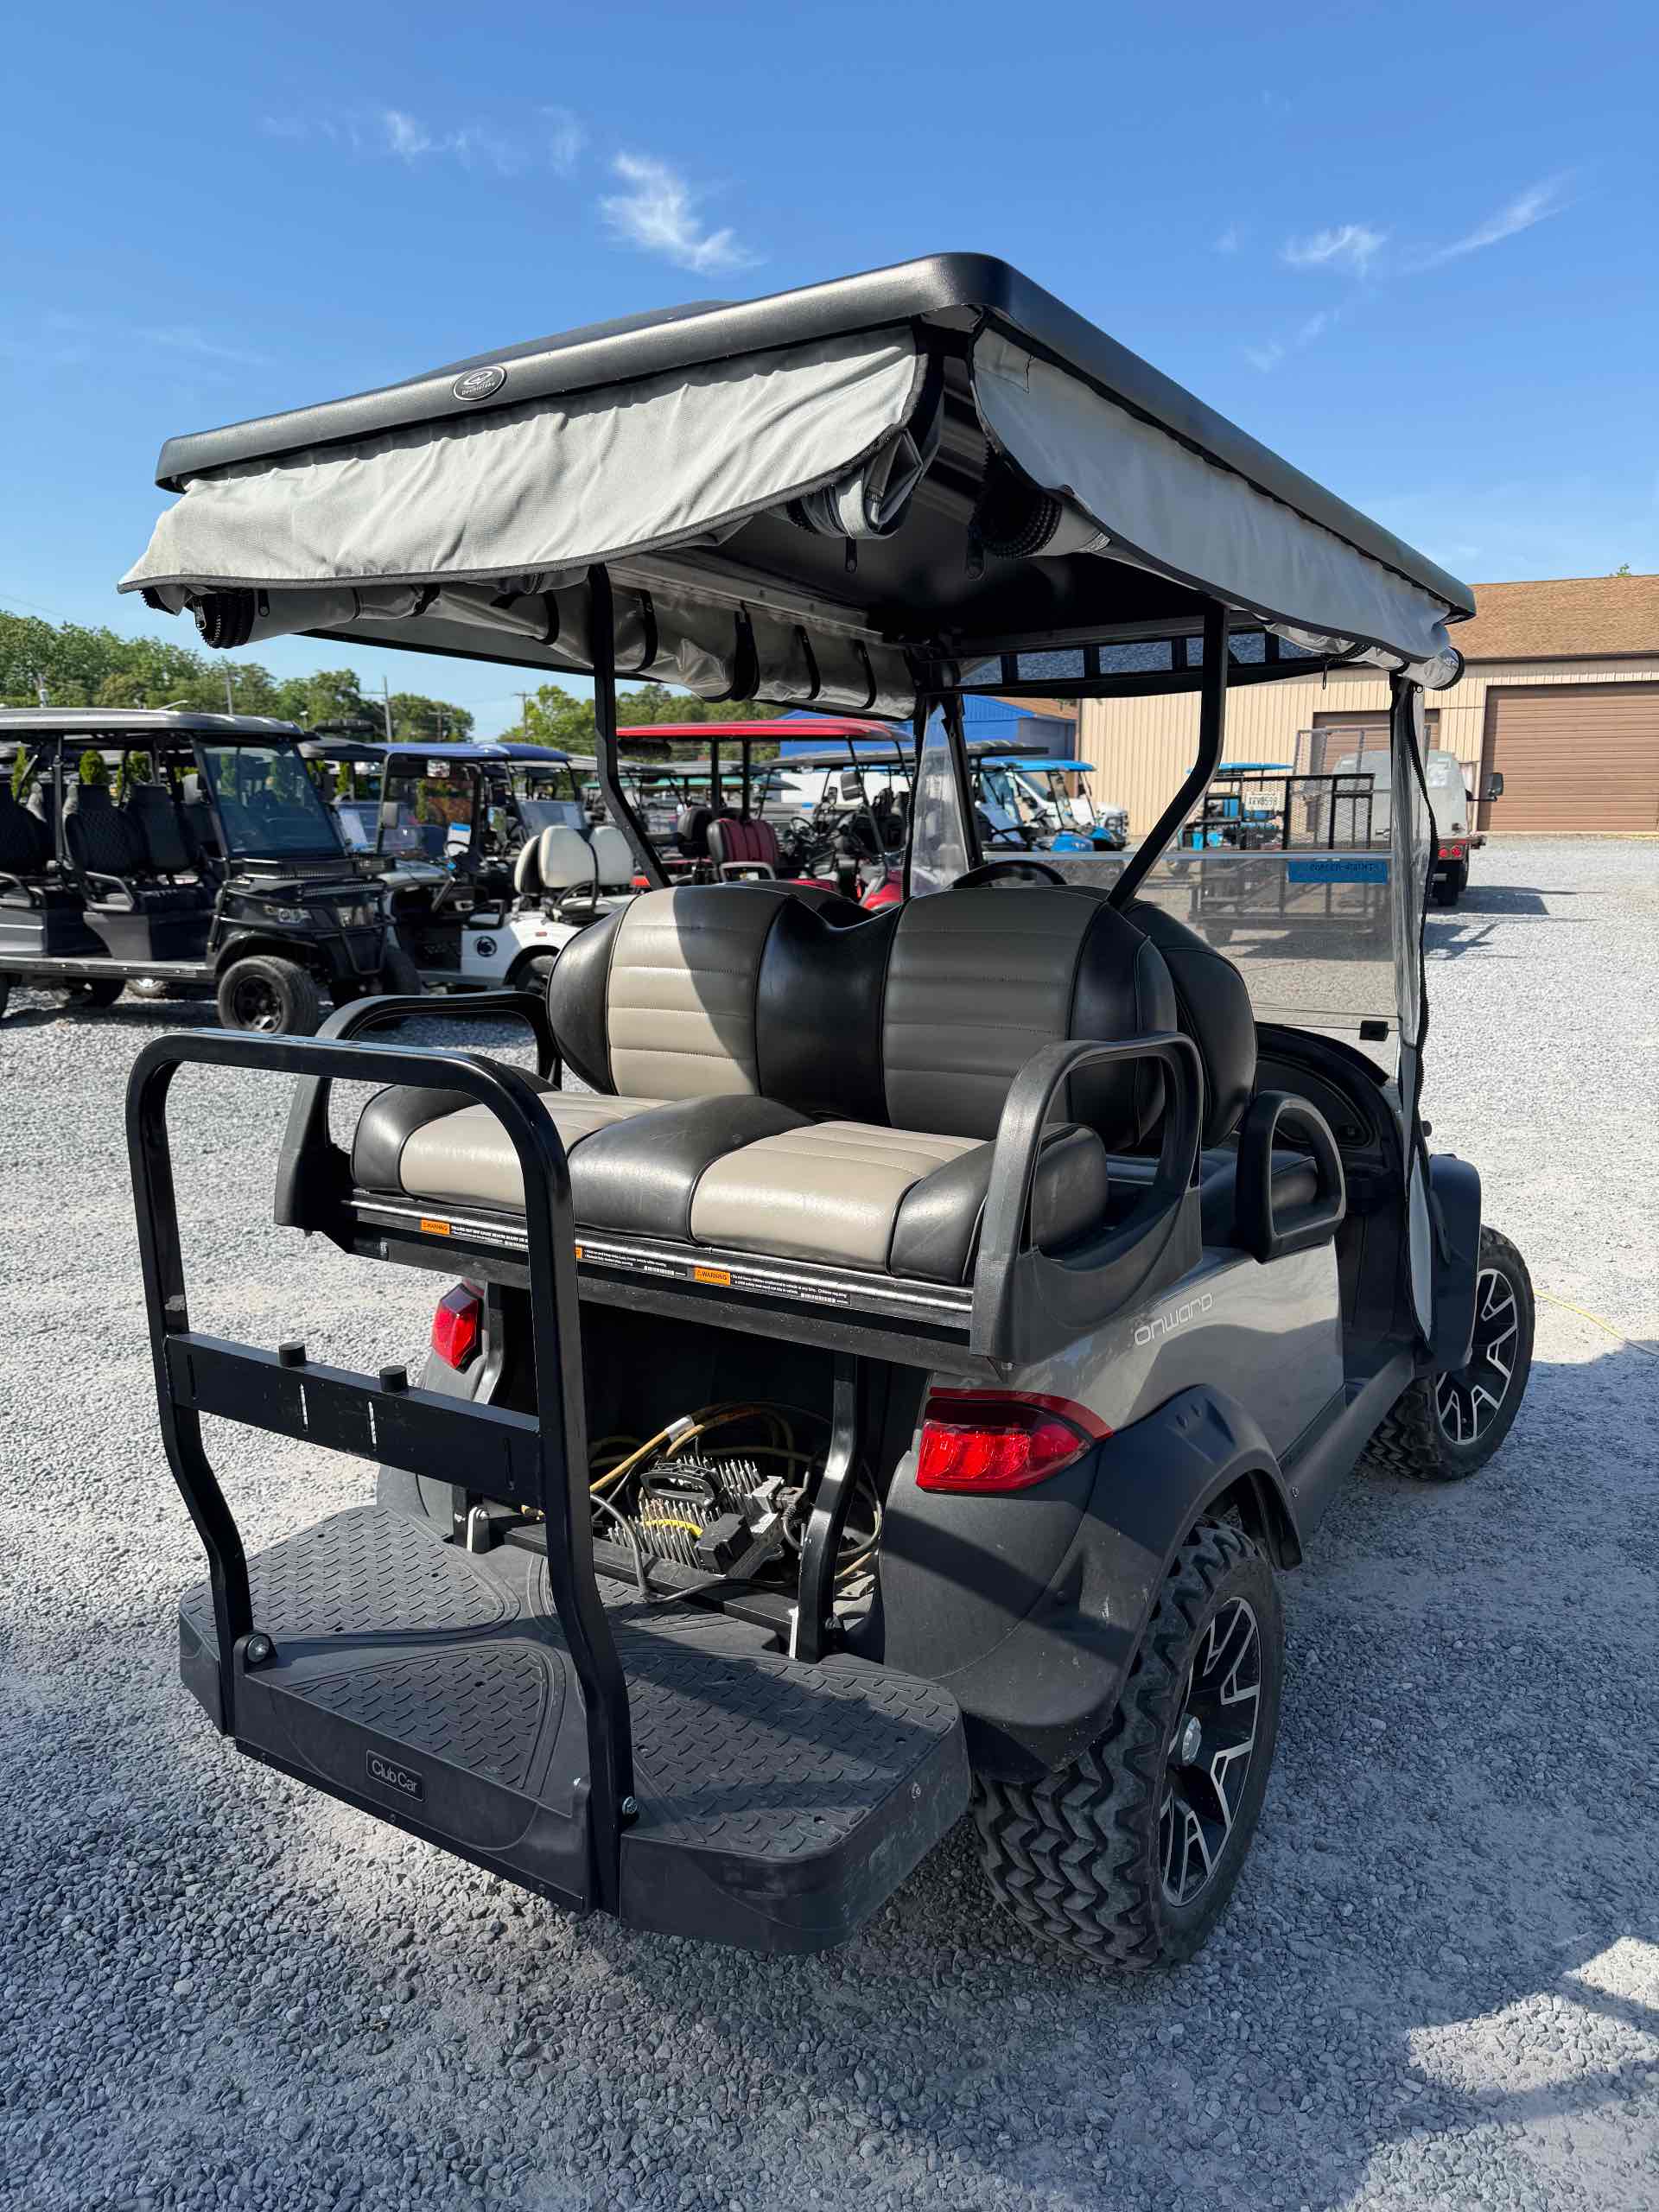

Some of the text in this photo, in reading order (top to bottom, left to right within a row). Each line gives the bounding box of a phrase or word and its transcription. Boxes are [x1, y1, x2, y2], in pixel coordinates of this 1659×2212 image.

[702, 1271, 728, 1281] WARNING
[372, 1759, 417, 1793] Club Car
